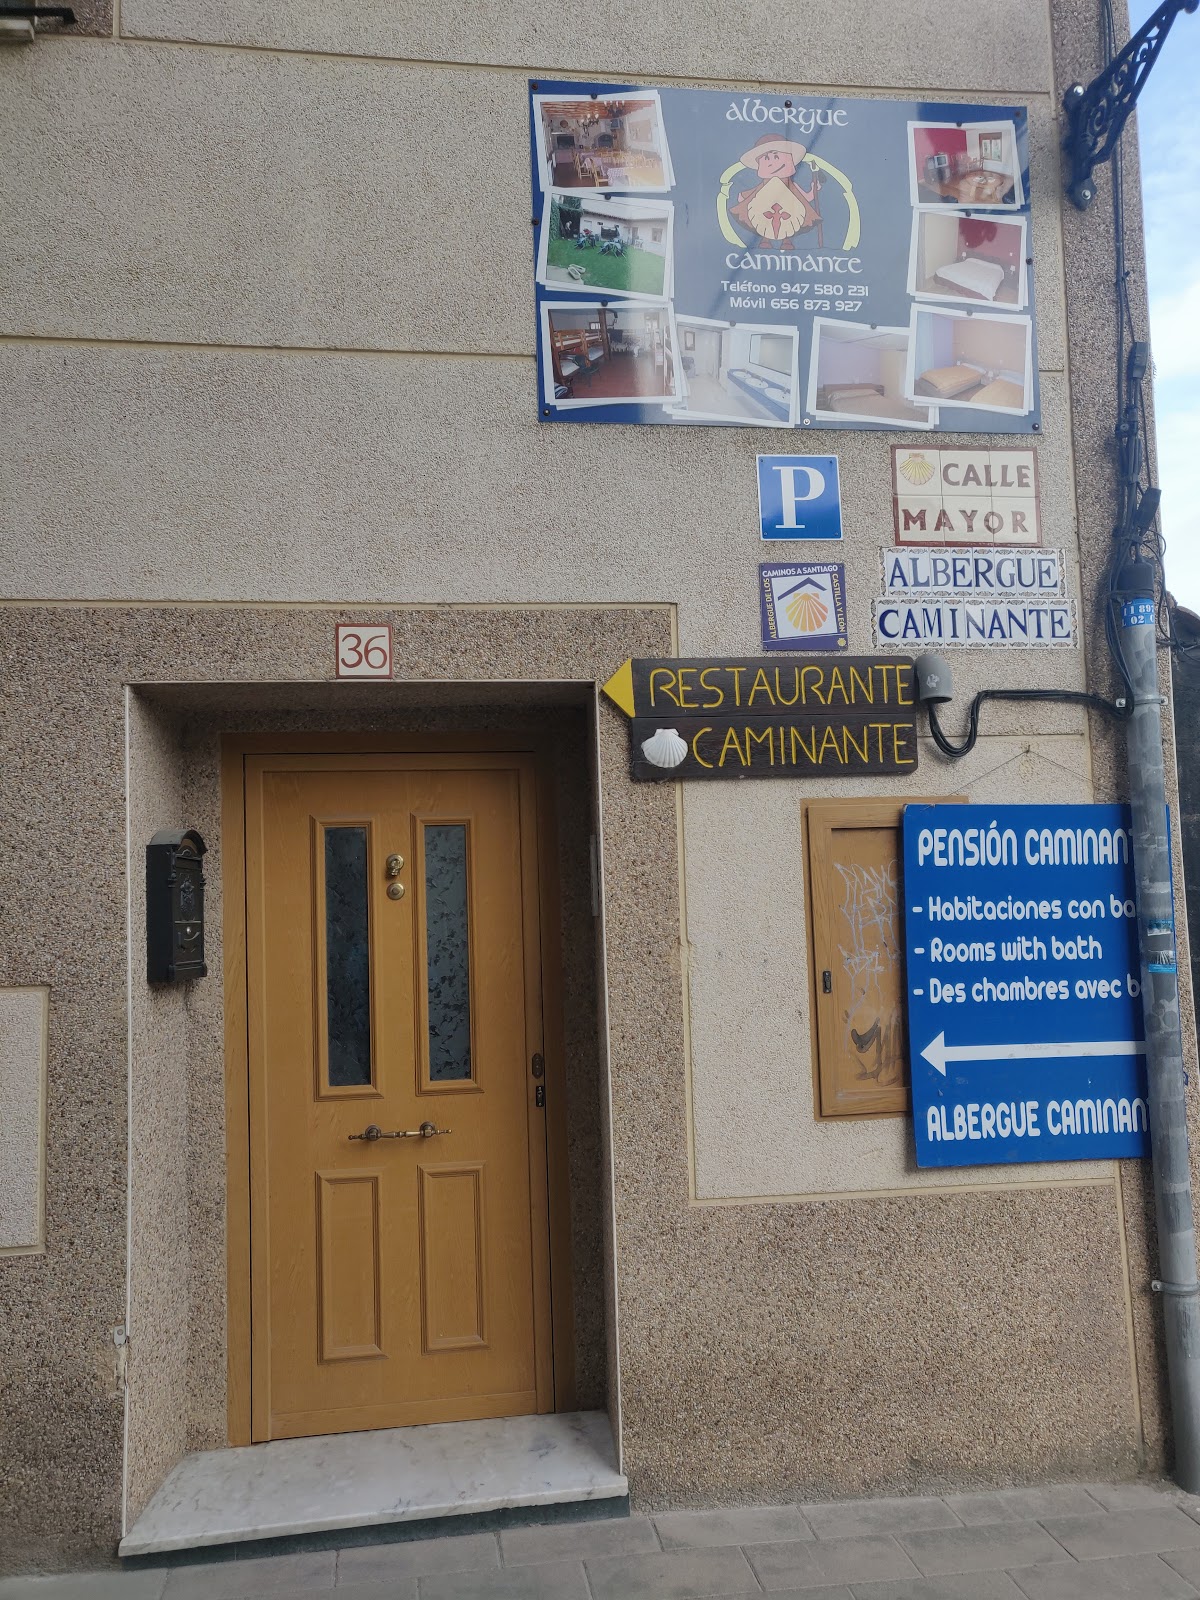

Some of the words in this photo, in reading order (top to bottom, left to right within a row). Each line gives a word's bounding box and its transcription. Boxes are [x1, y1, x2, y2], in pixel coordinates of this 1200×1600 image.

[726, 250, 863, 274] caminante
[721, 280, 776, 294] Teléfono
[781, 283, 810, 294] 947
[814, 284, 844, 296] 580
[848, 285, 869, 296] 231
[730, 297, 766, 309] Móvil
[771, 298, 799, 310] 656
[804, 300, 830, 311] 873
[835, 301, 862, 312] 927
[943, 463, 1031, 488] CALLE
[772, 466, 826, 529] P
[902, 508, 1029, 534] MAYOR
[762, 568, 796, 577] CAMINOS
[802, 565, 838, 574] SANTIAGO
[889, 557, 1058, 588] ALBERGUE
[763, 578, 771, 594] LOS
[765, 594, 772, 602] DE
[832, 574, 842, 607] CASTILLA
[837, 613, 846, 632] LEÓN
[766, 602, 777, 639] ALBERGUE
[878, 607, 1071, 639] CAMINANTE
[341, 633, 387, 669] 36
[650, 664, 914, 708] RESTAURANTE
[692, 723, 914, 768] CAMINANTE
[918, 820, 1017, 867] PENSIÓN
[1024, 827, 1134, 866] CAMINAN
[928, 895, 1062, 921] Habitaciones
[1067, 898, 1105, 918] con
[930, 937, 996, 962] Rooms
[1001, 936, 1047, 961] with
[1051, 935, 1102, 960] bath
[930, 977, 966, 1004] Des
[971, 976, 1069, 1003] chambres
[1074, 979, 1121, 1001] avec
[926, 1101, 1041, 1141] ALBERGUE
[1046, 1097, 1149, 1136] CAMINAN
